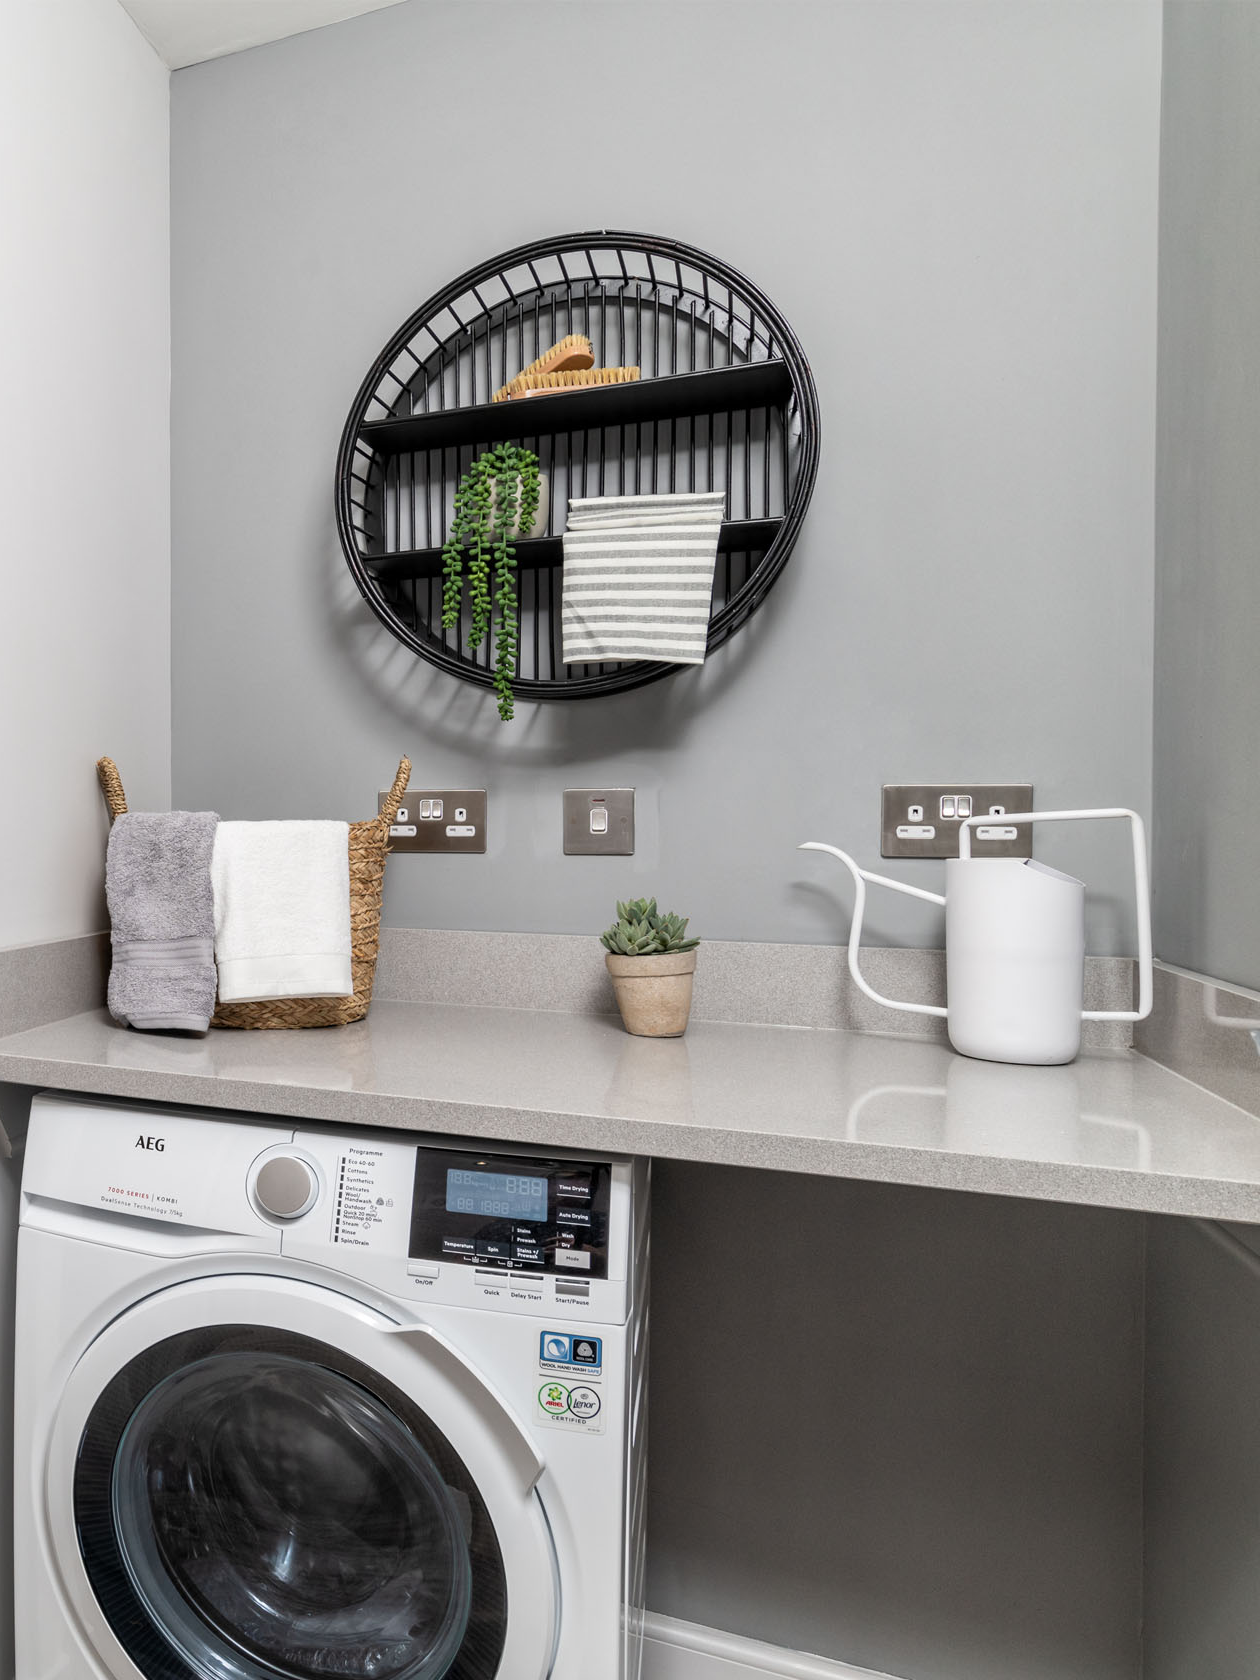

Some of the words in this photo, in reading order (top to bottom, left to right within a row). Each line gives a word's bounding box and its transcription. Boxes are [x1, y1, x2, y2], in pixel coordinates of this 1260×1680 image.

[135, 1135, 166, 1152] AEG
[349, 1148, 383, 1157] Programme
[346, 1177, 374, 1185] Synthetics
[345, 1185, 370, 1193] Delicates
[572, 1185, 589, 1194] Drying
[108, 1186, 125, 1195] 7000
[126, 1190, 149, 1200] SERIES
[156, 1196, 178, 1205] KOMBI
[100, 1195, 132, 1207] DualSense
[133, 1202, 167, 1214] Technology
[344, 1197, 372, 1205] Handwash
[343, 1203, 366, 1211] Outdoor
[572, 1213, 589, 1222] Drying
[516, 1227, 532, 1235] Stains
[340, 1237, 370, 1246] Spin/Drain
[443, 1240, 474, 1250] Temperature
[516, 1237, 537, 1245] Prewash
[516, 1252, 539, 1260] Prewash
[414, 1278, 434, 1286] On/Off
[483, 1288, 500, 1297] Quick
[510, 1292, 527, 1300] Delay
[555, 1297, 590, 1306] Start/Pause
[545, 1400, 565, 1409] ARIEL
[572, 1398, 597, 1410] Lenor
[551, 1415, 587, 1425] CERTIFIED
